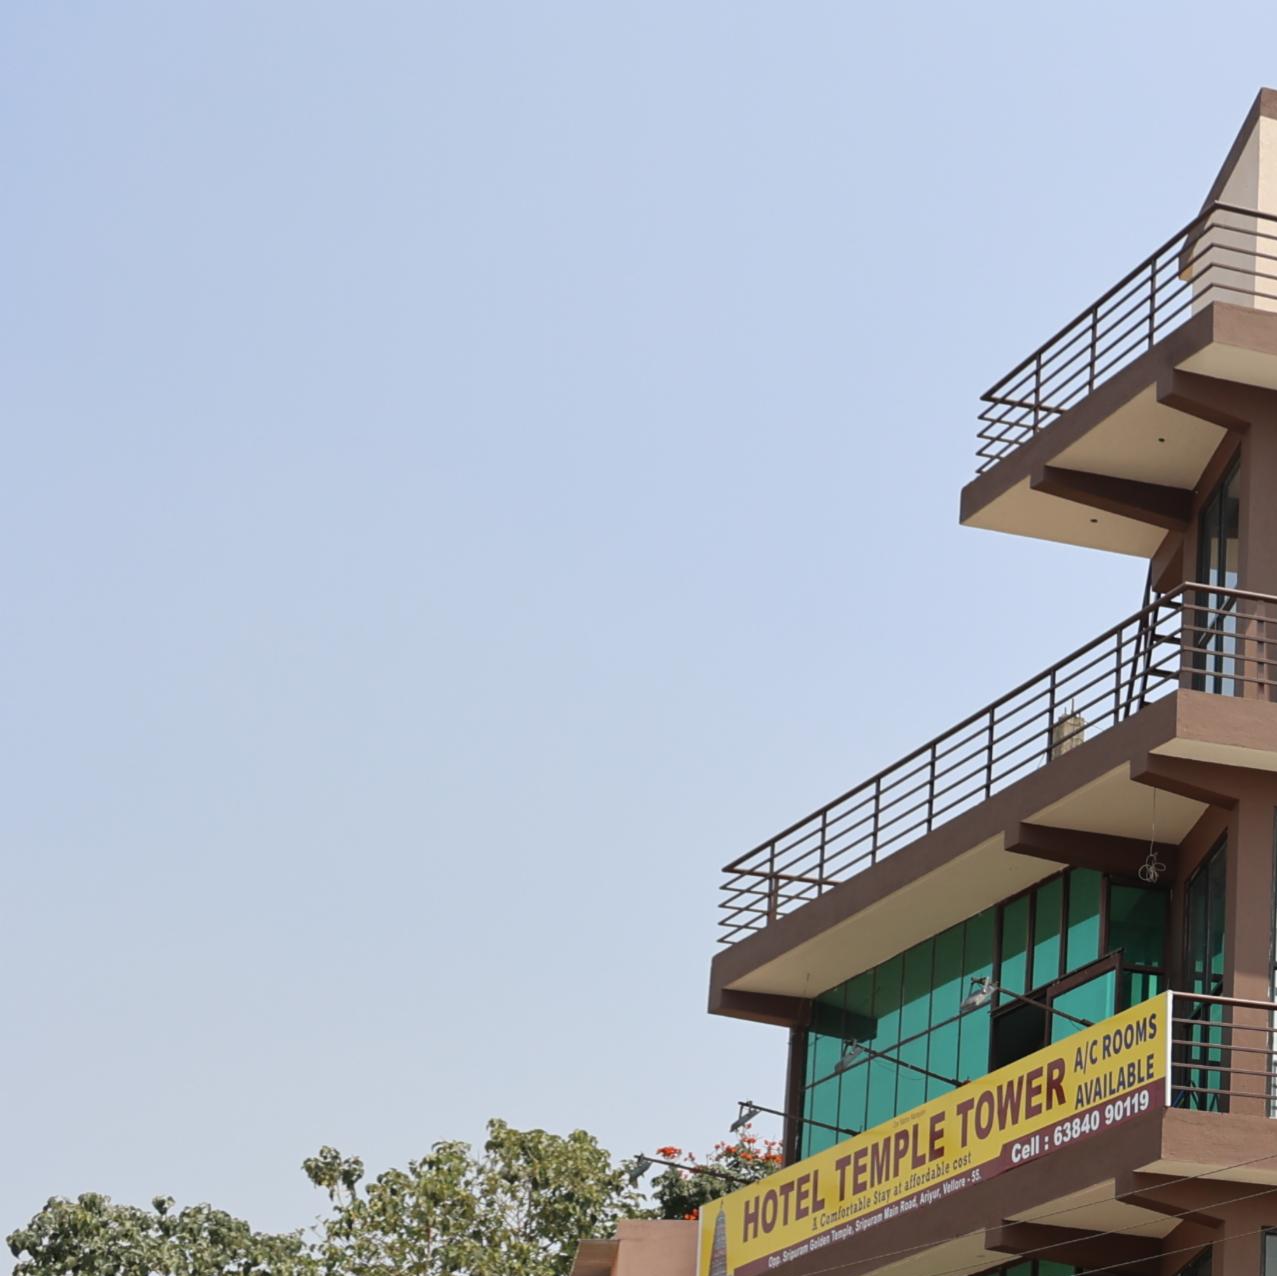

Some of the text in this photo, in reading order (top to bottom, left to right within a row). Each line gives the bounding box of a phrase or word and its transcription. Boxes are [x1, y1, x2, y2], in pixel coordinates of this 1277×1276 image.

[1074, 1013, 1157, 1074] A/C ROOMS
[1075, 1054, 1154, 1110] AVAILABLE
[743, 1058, 1067, 1242] HOTEL TEMPLE TOWER
[1012, 1135, 1039, 1163] Cell
[1054, 1111, 1100, 1146] 63840
[1105, 1090, 1149, 1124] 90119
[782, 1239, 809, 1262] Sripuram
[810, 1231, 830, 1250] Golden
[855, 1211, 883, 1232] Sripuram
[884, 1206, 899, 1220] Main
[943, 1177, 966, 1194] Vellore
[812, 1152, 972, 1230] A Comfortable Stay at affordable cost
